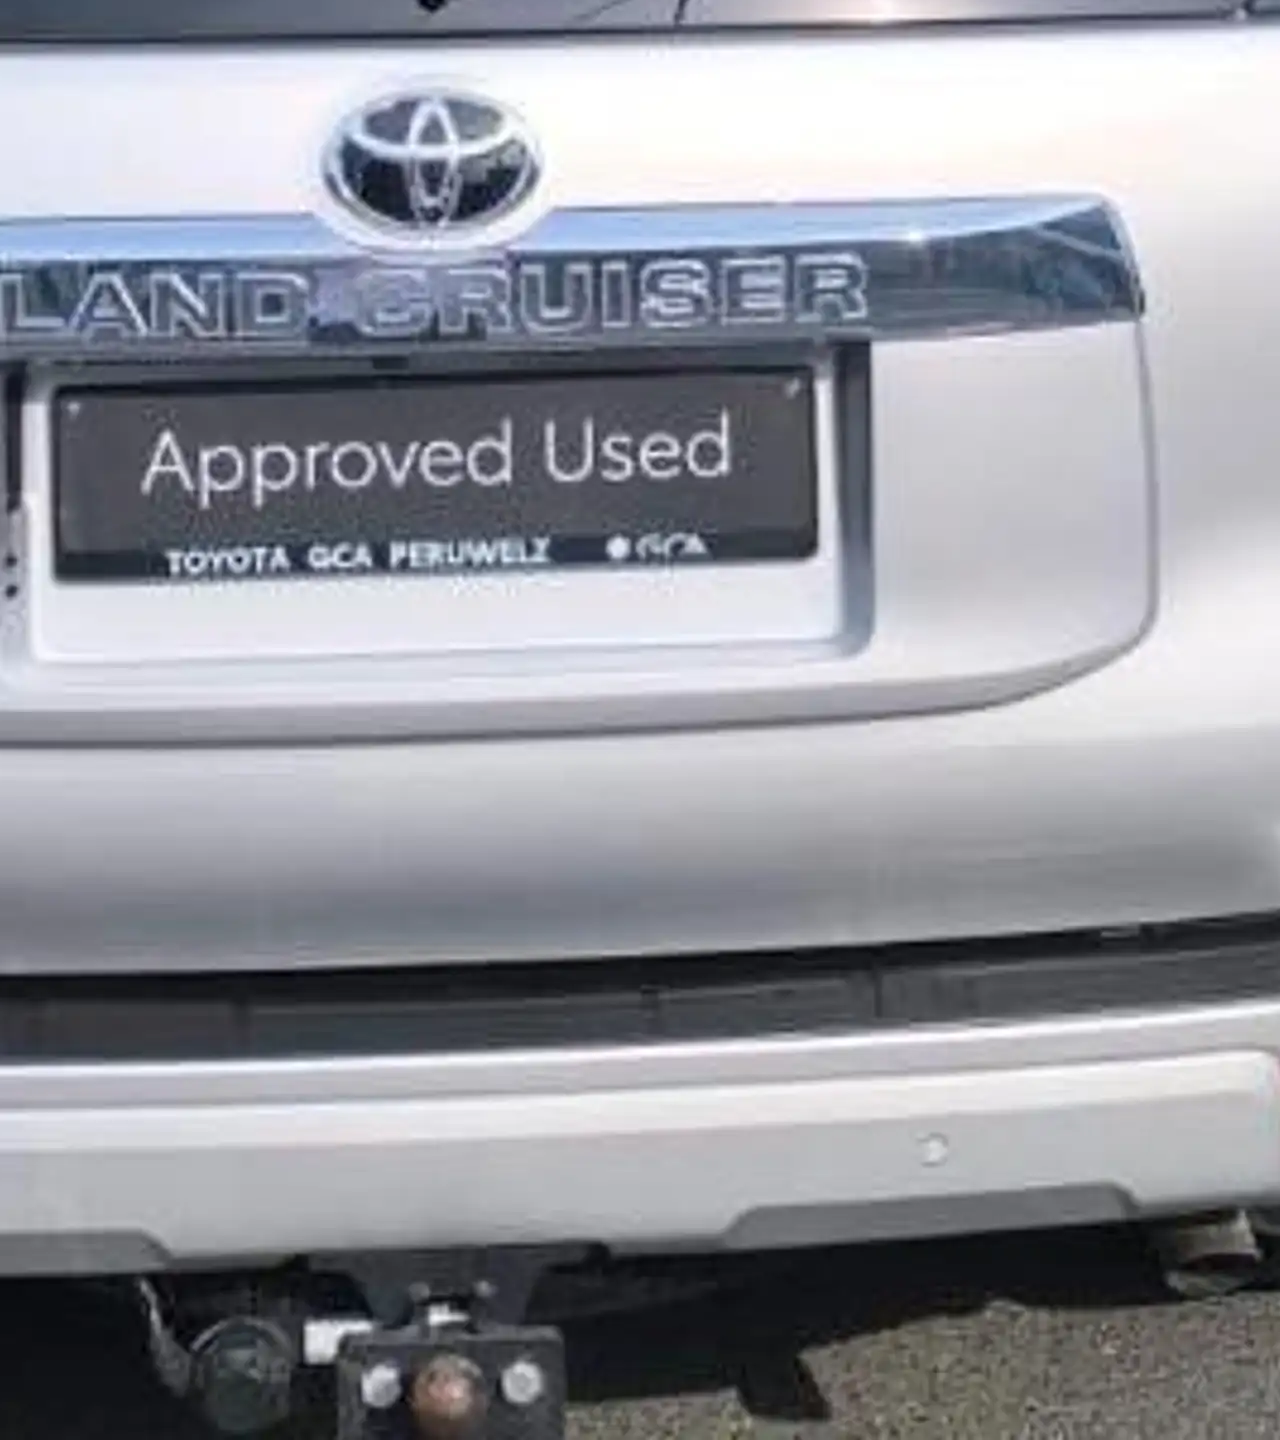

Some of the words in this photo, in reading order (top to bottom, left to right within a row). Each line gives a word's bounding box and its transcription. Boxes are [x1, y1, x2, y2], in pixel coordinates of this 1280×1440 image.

[354, 252, 870, 339] CRUISER
[140, 417, 514, 510] Approved
[543, 410, 733, 484] Used
[166, 544, 291, 576] TOYOTA
[307, 540, 374, 570] GCA
